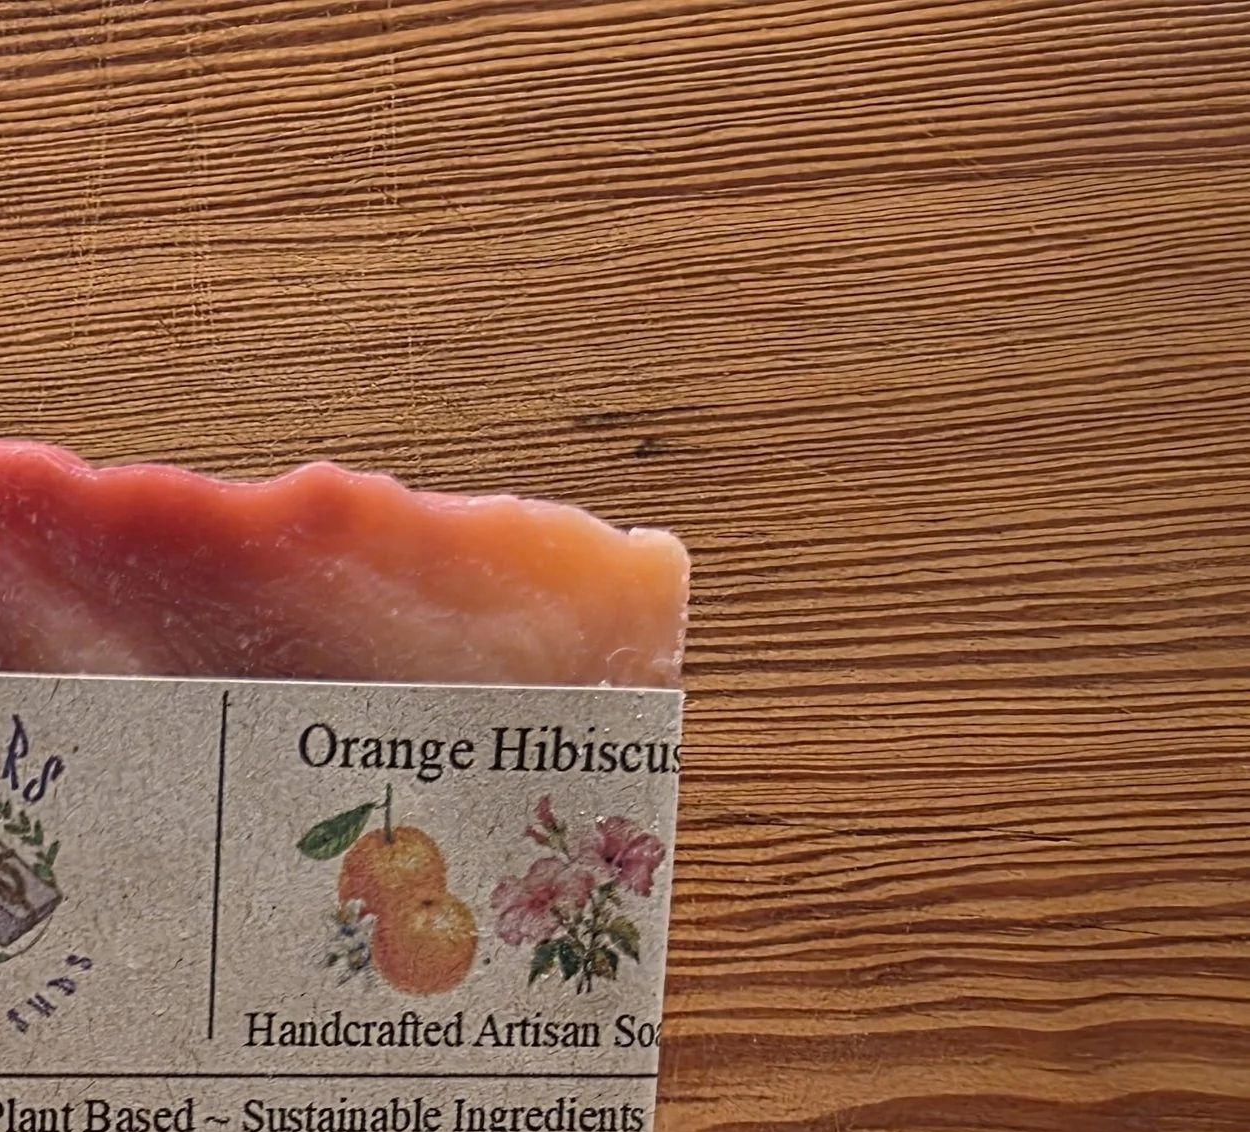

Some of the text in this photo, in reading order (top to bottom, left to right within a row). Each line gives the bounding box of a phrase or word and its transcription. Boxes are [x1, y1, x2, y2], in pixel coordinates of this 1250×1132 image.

[298, 722, 681, 783] Orange Hibiscus
[243, 1010, 465, 1048] Handcrafted
[472, 1011, 601, 1048] Artisan
